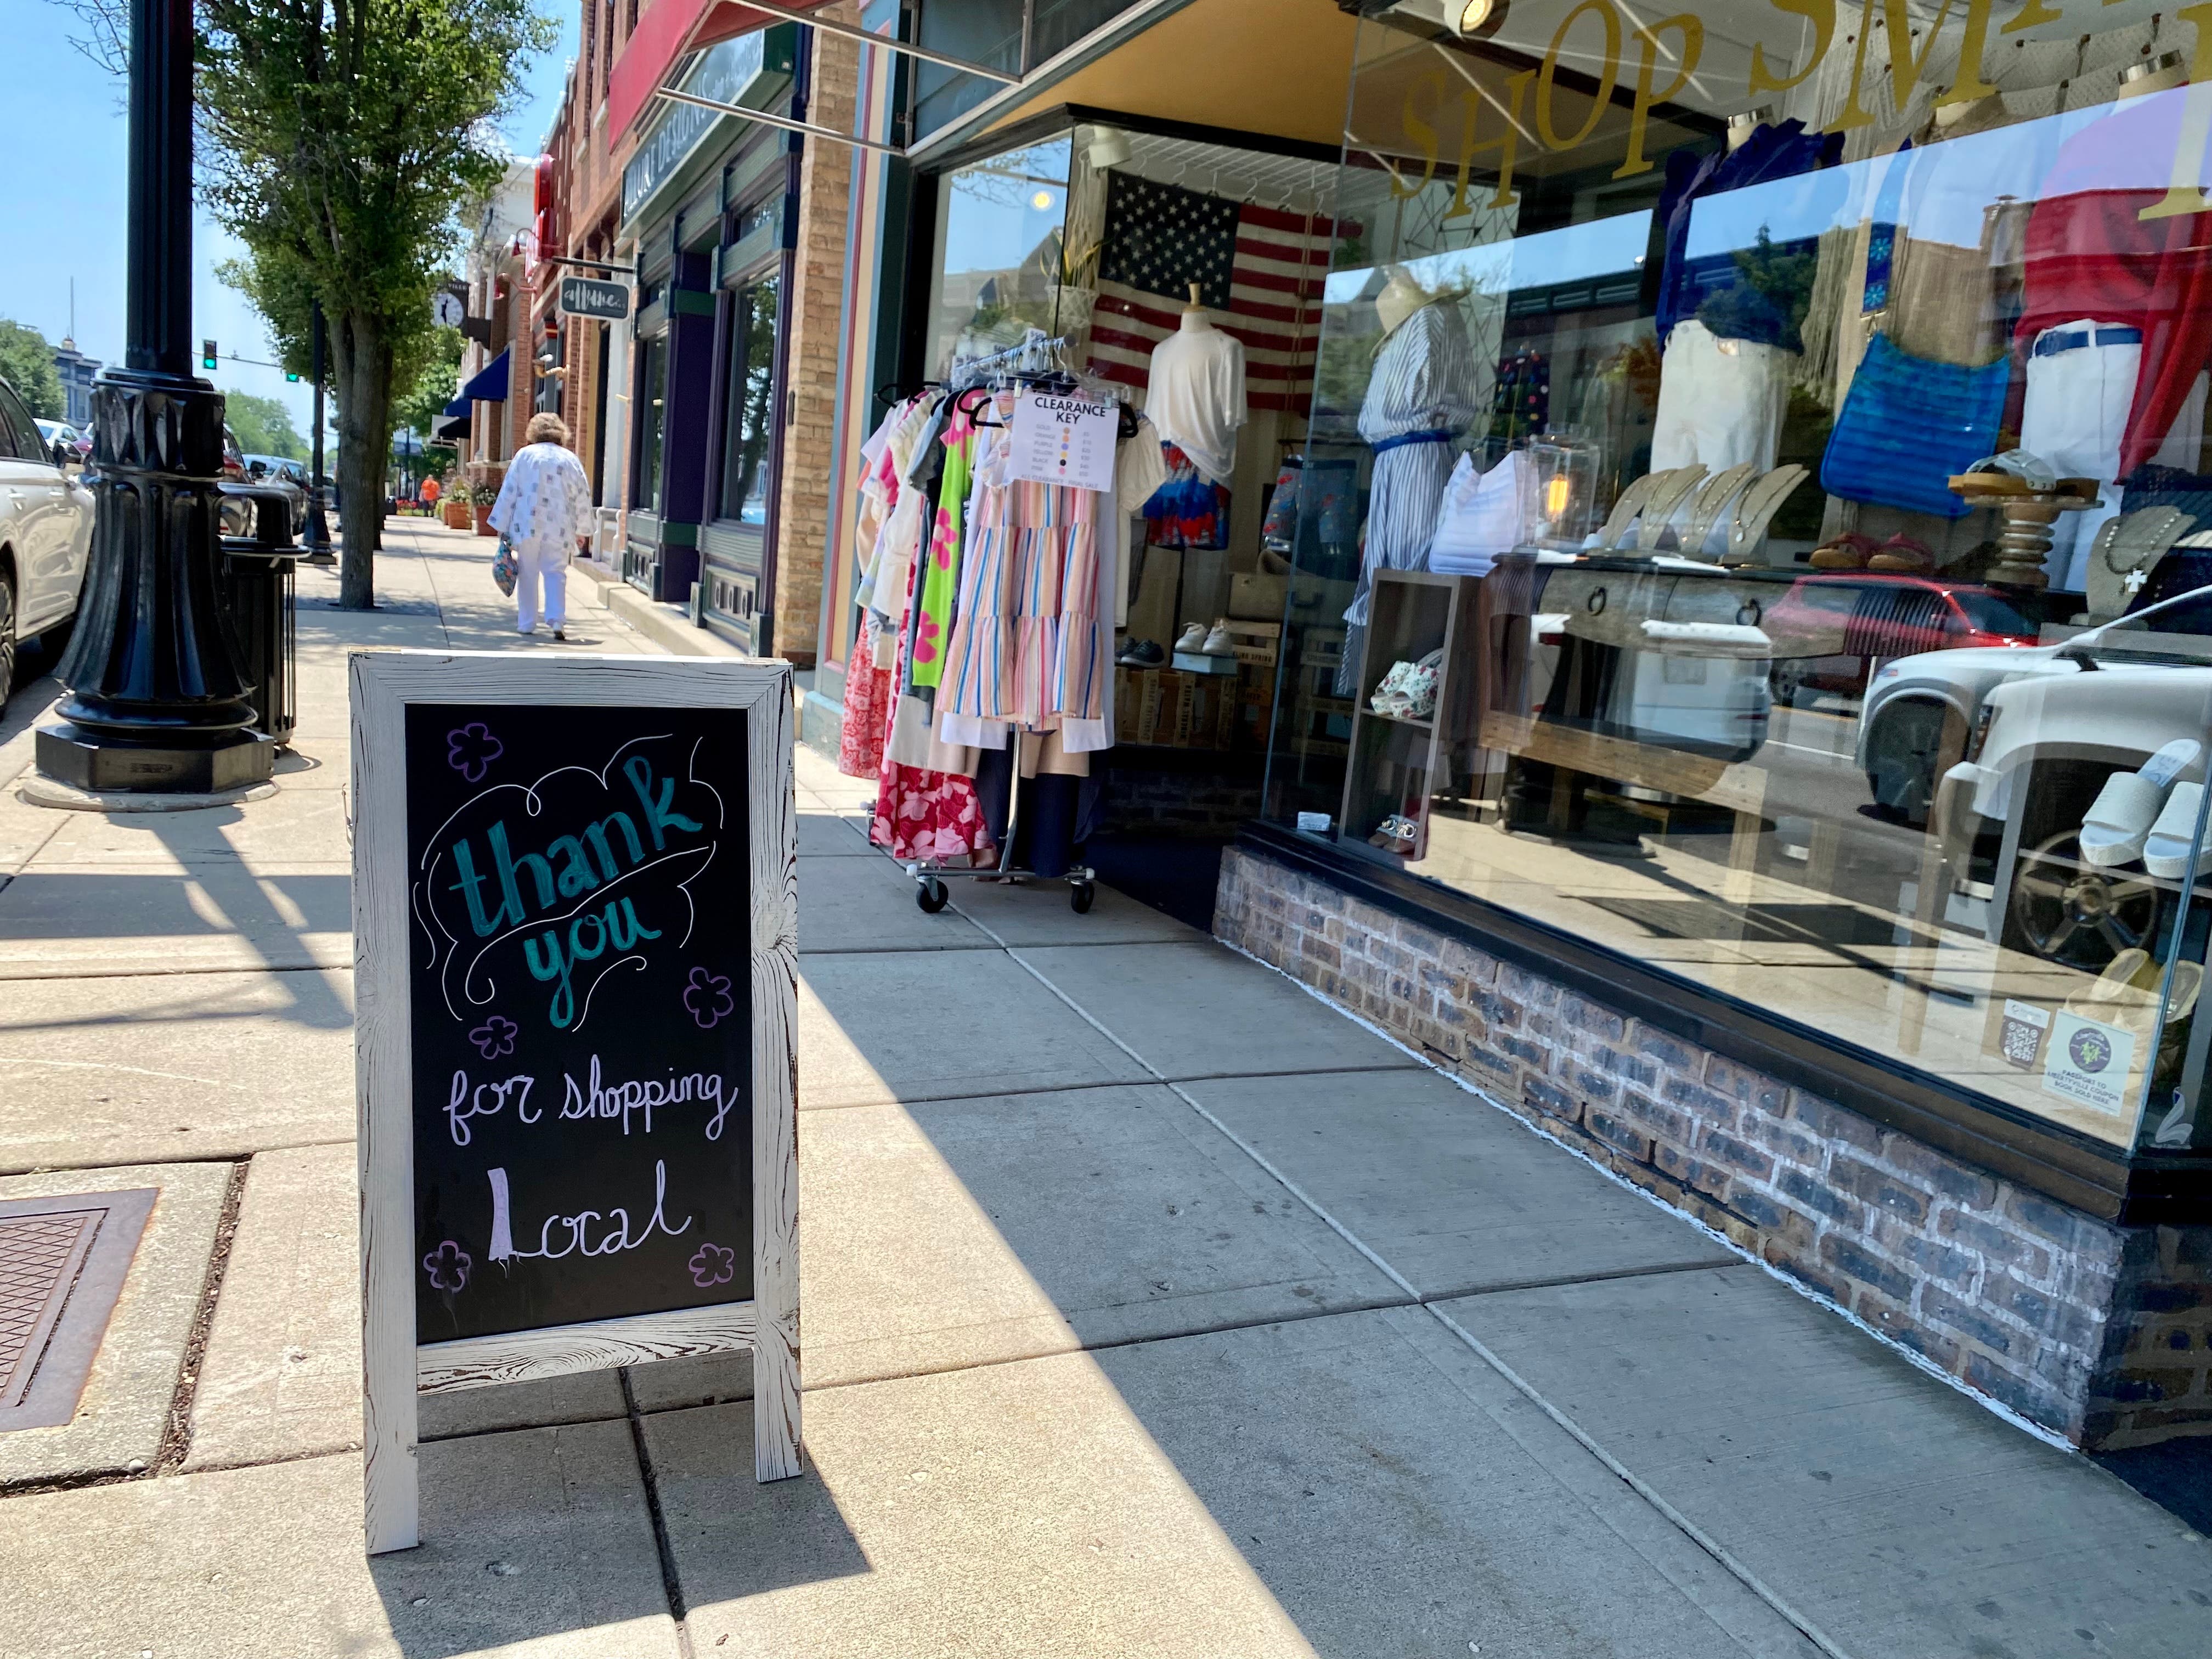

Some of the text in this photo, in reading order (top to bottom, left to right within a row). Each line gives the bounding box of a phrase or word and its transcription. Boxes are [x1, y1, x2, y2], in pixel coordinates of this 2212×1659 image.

[1390, 0, 1704, 219] SHOP
[1748, 0, 2123, 134] SM
[1035, 397, 1106, 417] CLEARANCE
[1056, 411, 1080, 424] KEY
[449, 756, 703, 937] thank
[523, 897, 662, 1028] you
[443, 1054, 738, 1146] for shopping
[2090, 1086, 2119, 1101] COUPON
[488, 1159, 692, 1262] Local
